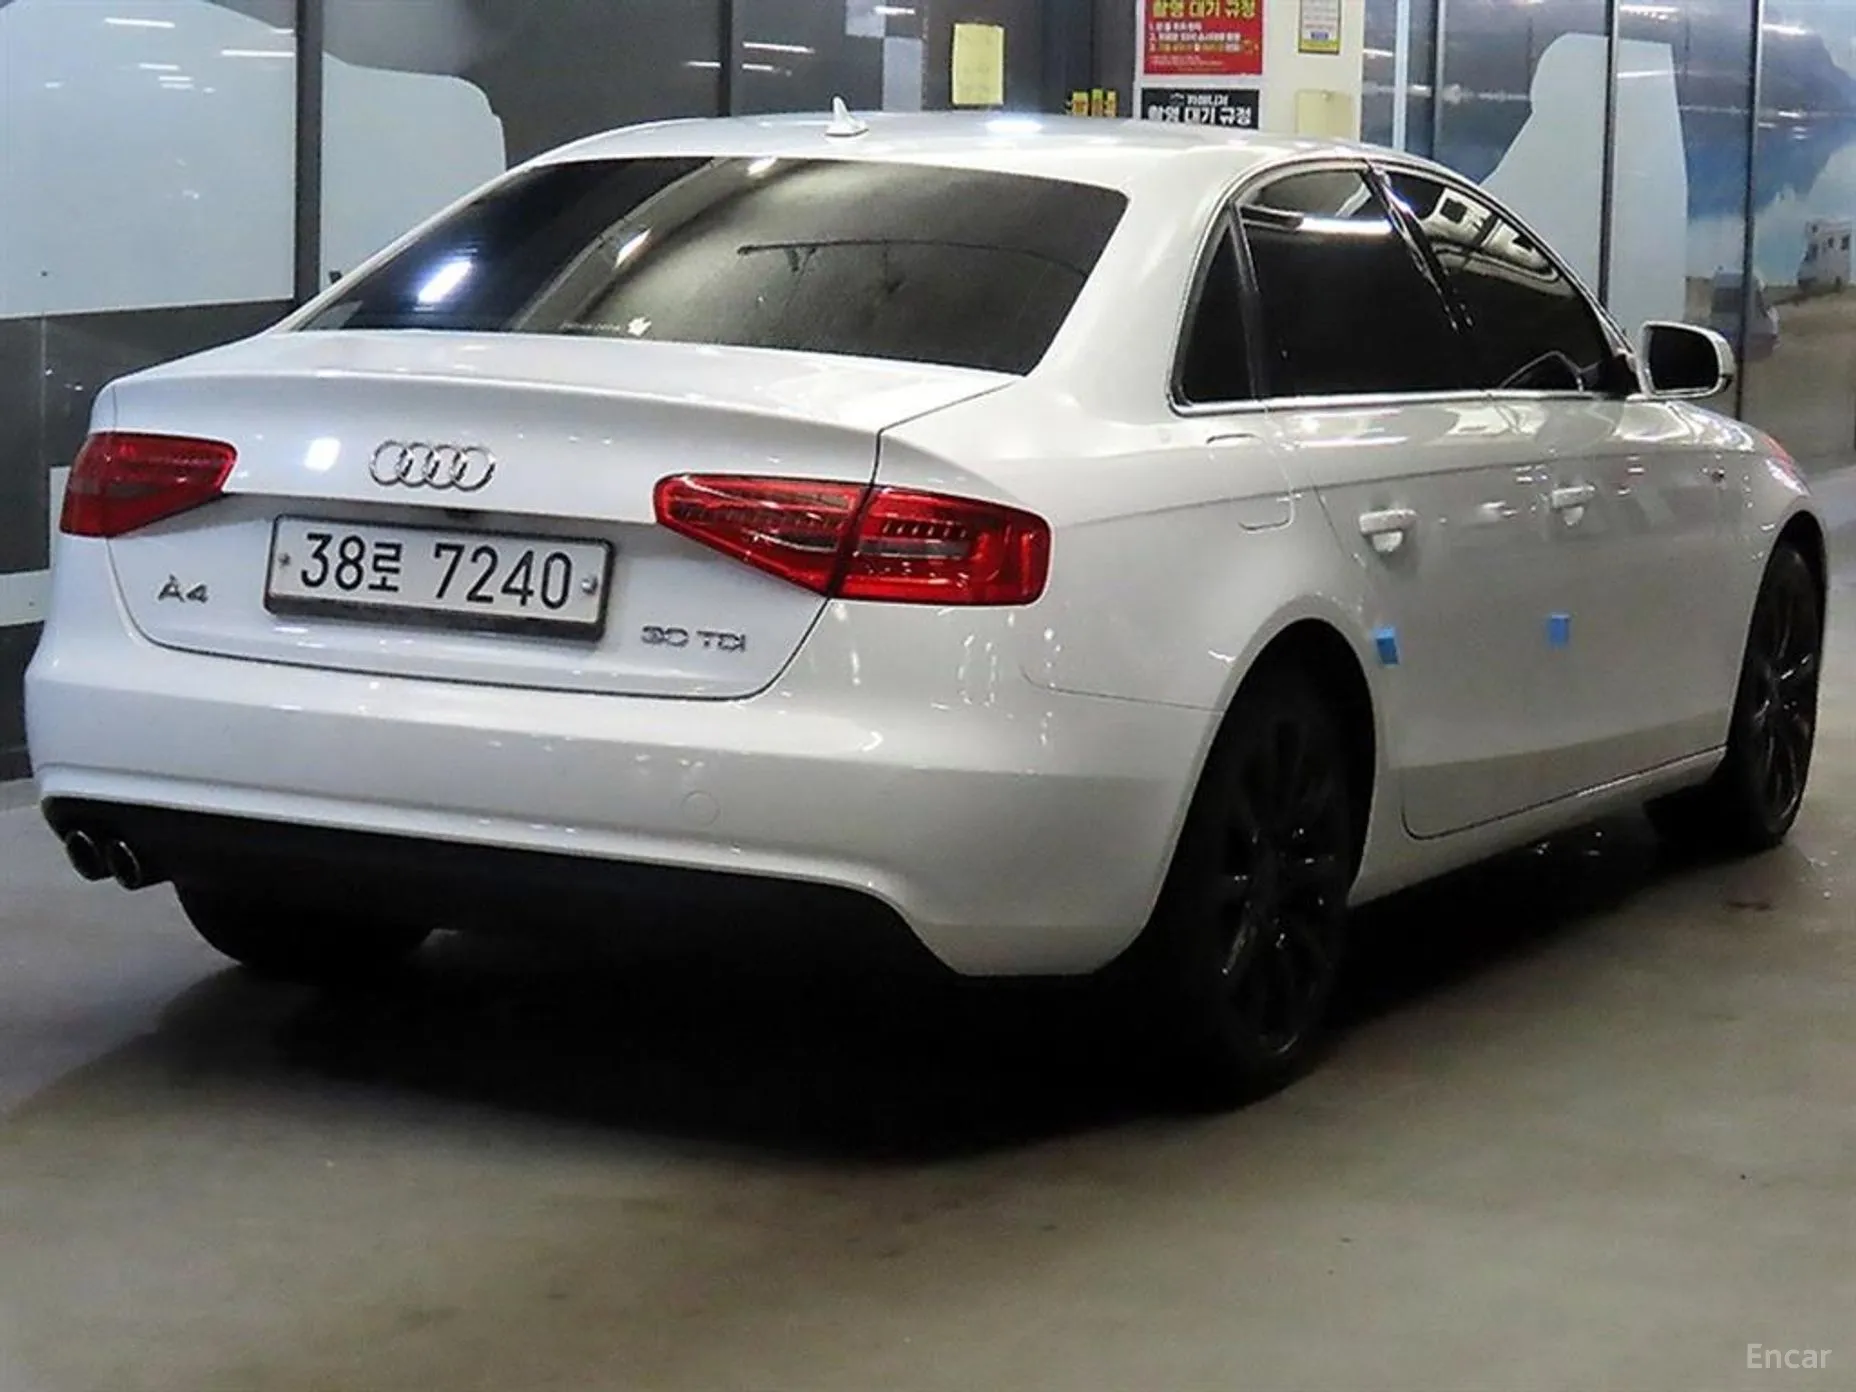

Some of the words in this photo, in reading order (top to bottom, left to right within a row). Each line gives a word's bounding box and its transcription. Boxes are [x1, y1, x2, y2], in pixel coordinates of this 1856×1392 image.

[300, 531, 403, 593] 38로
[433, 541, 573, 610] 7240
[156, 573, 208, 605] A4
[640, 625, 690, 647] 30
[695, 630, 747, 652] TDI
